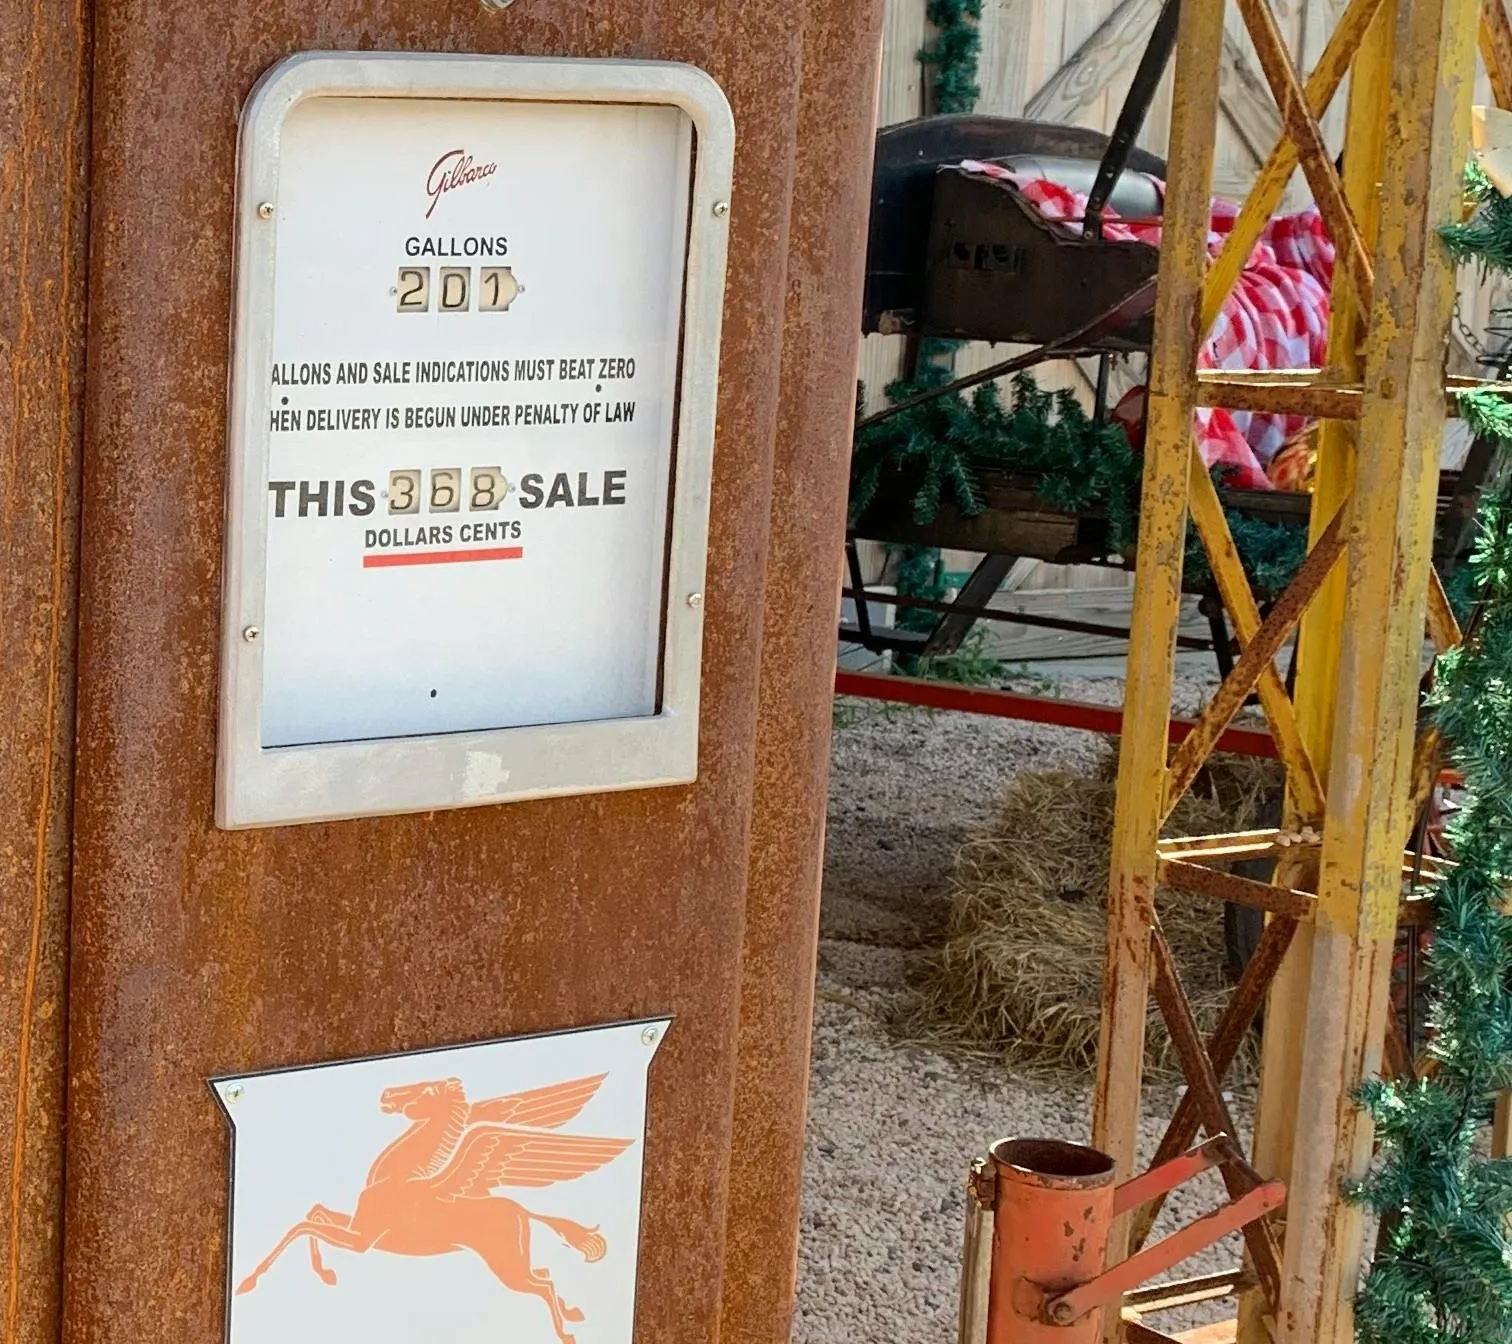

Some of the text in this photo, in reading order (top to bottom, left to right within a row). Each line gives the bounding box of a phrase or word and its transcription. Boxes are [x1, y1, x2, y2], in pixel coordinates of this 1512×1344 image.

[425, 148, 499, 220] Gilbarco
[405, 236, 509, 257] GALLONS
[336, 361, 368, 385] AND
[372, 361, 411, 384] SALE
[415, 359, 510, 384] INDICATIONS
[514, 358, 555, 382] MUST
[559, 358, 595, 380] BEAT
[598, 357, 636, 379] ZERO
[306, 408, 381, 432] DELIVERY
[385, 407, 400, 430] IS
[404, 406, 456, 429] BEGUN
[461, 404, 510, 427] UNDER
[514, 403, 579, 426] PENALTY
[583, 402, 601, 424] OF
[605, 401, 636, 423] LAW
[268, 479, 376, 518] THIS
[518, 470, 627, 510] SALE
[364, 520, 522, 548] DOLLARS CENTS
